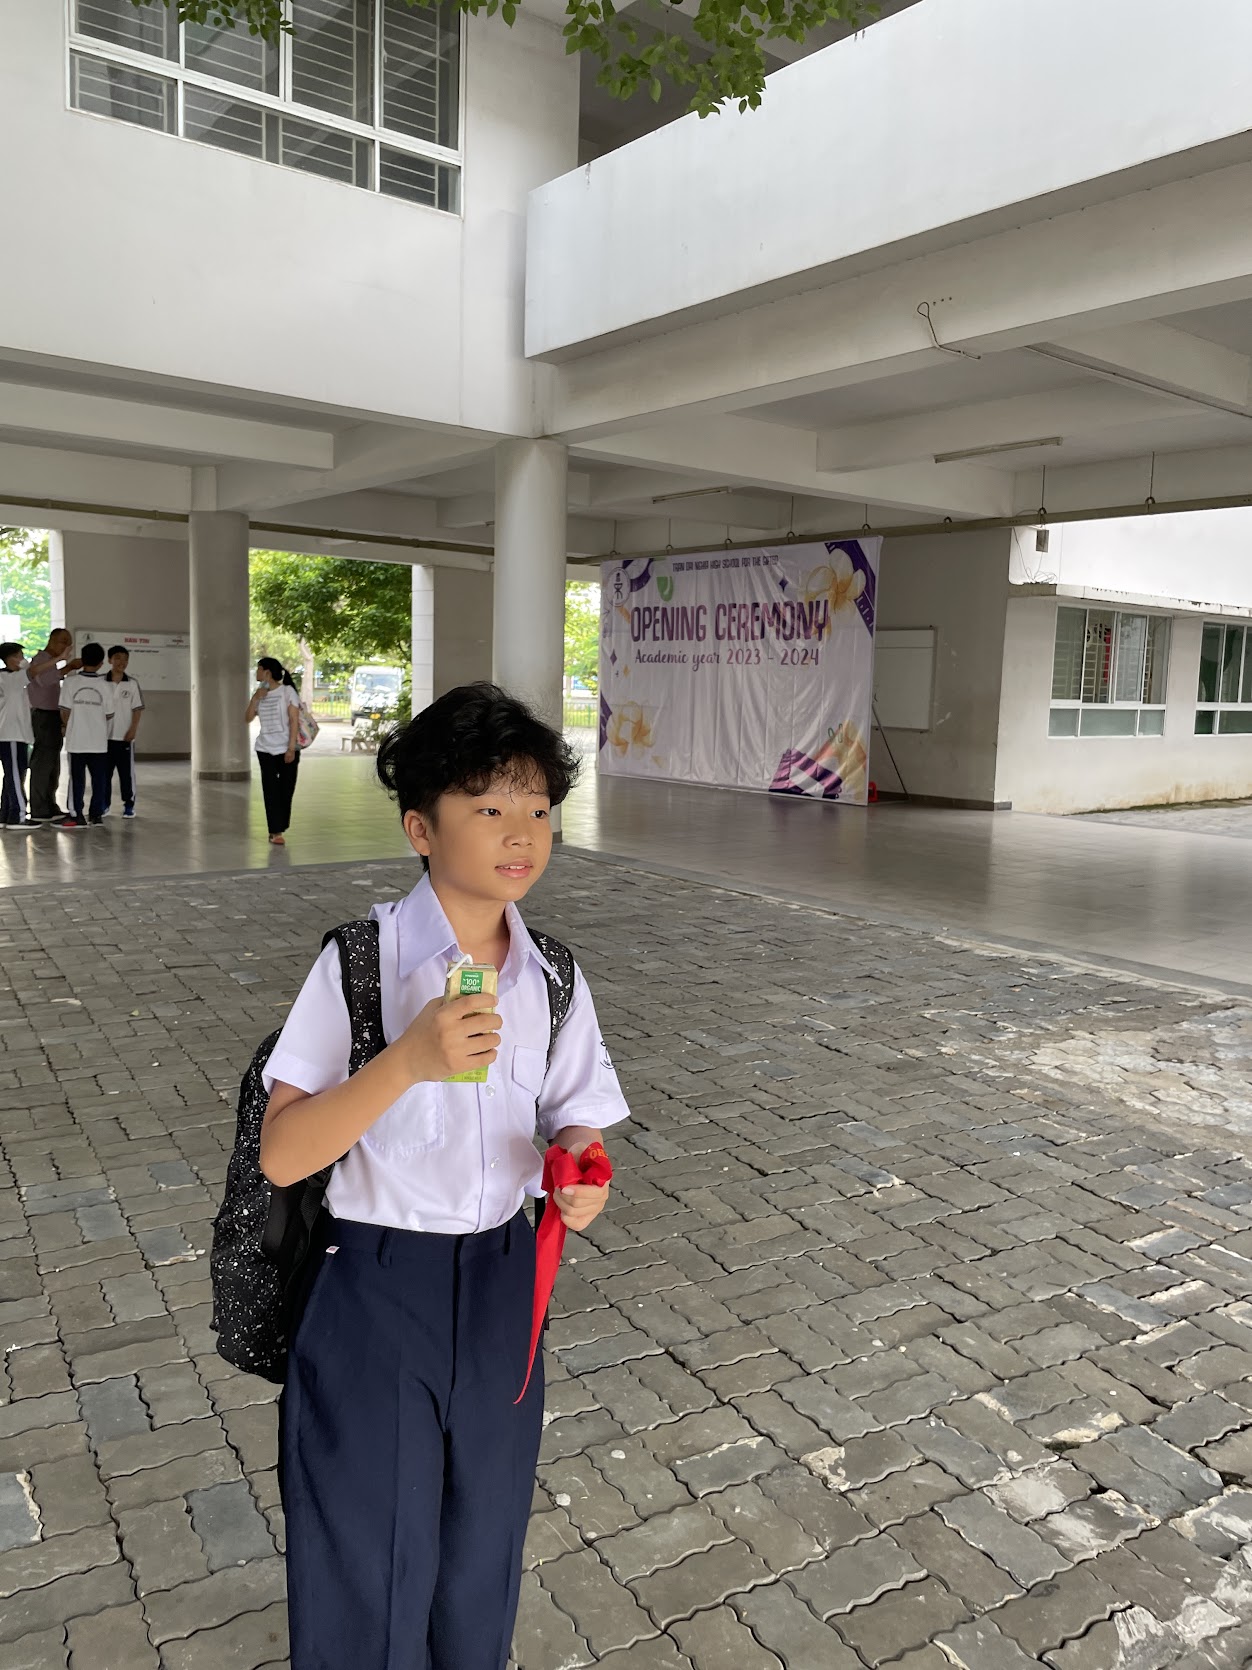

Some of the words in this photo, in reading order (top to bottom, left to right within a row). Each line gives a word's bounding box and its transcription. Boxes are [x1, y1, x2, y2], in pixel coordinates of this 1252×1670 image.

[722, 558, 739, 568] SCHOOL
[742, 557, 751, 567] FOR
[753, 556, 761, 566] THE
[631, 604, 707, 642] OPENING
[715, 599, 829, 642] CEREMONY
[635, 649, 689, 663] Academic
[692, 652, 720, 671] year
[726, 648, 761, 665] 2023
[781, 647, 819, 666] 2024
